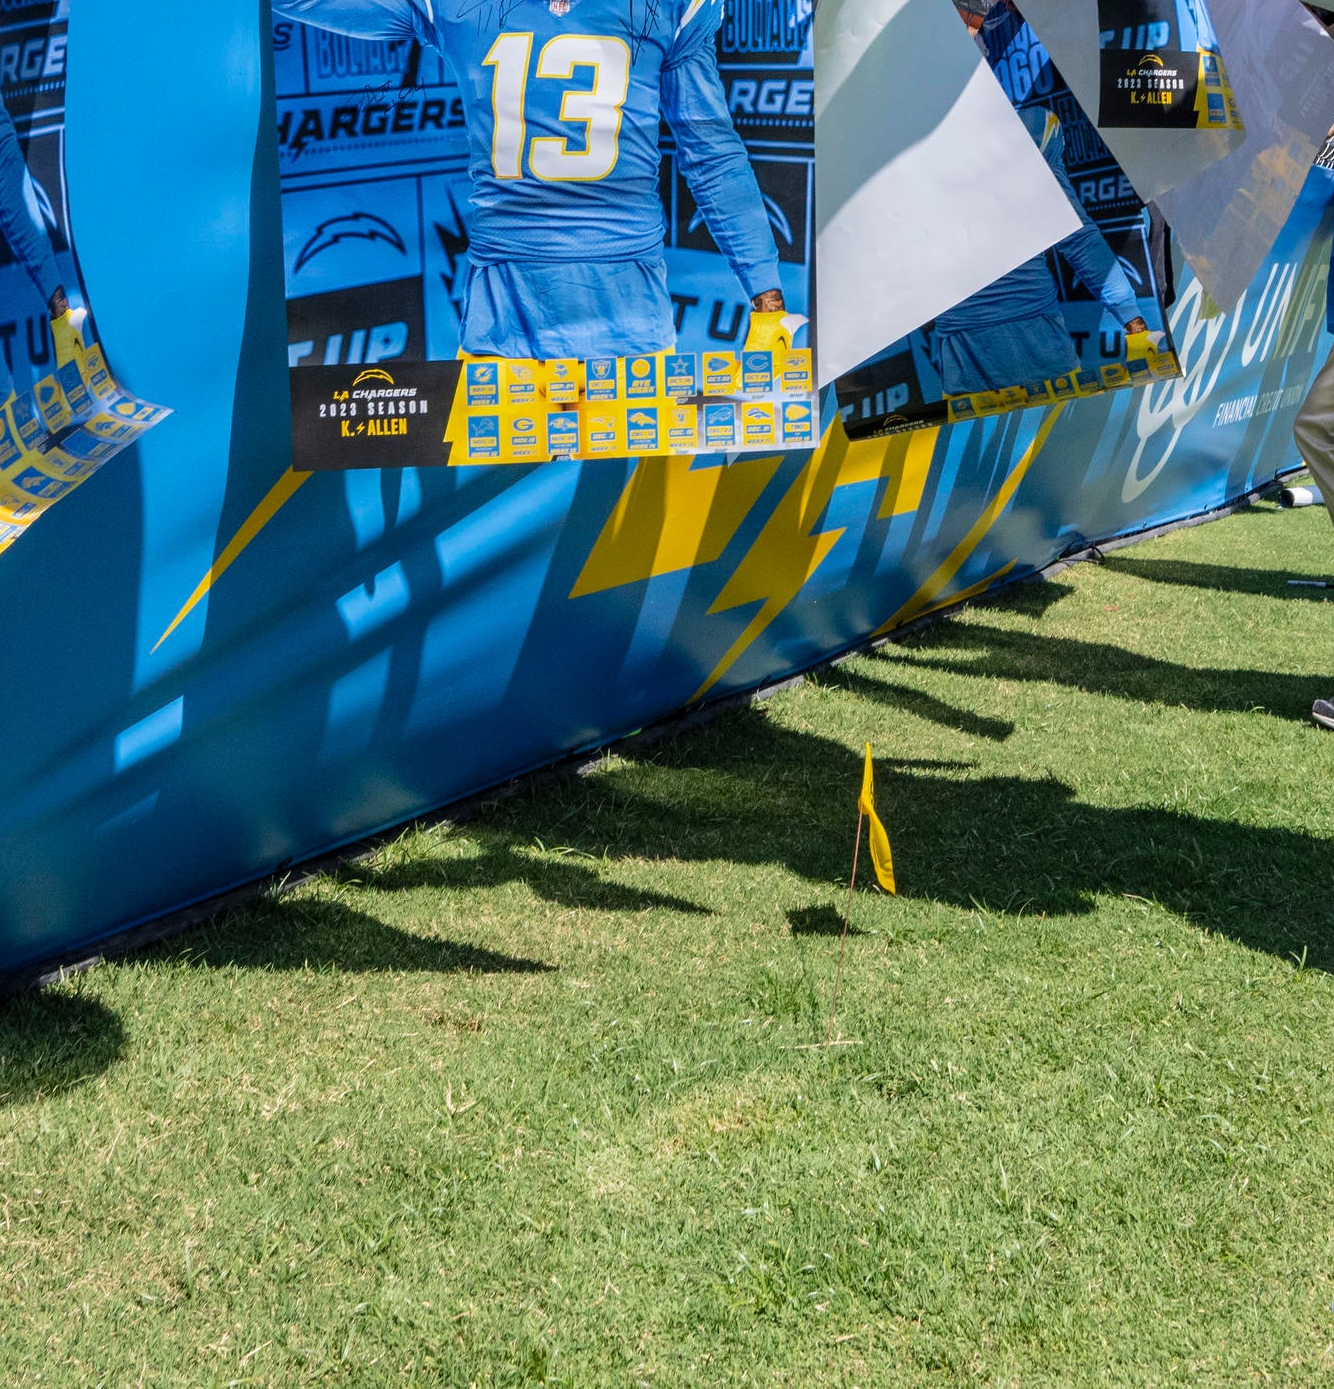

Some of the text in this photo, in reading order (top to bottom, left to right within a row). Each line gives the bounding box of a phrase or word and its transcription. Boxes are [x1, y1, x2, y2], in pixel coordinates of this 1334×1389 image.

[1126, 68, 1177, 78] LA CHARGERS
[1117, 78, 1184, 90] 2023 SEASON
[1130, 91, 1172, 105] K. ALLEN
[481, 31, 632, 183] 13
[332, 388, 418, 403] LA CHARGERS
[319, 400, 428, 417] 2023 SEASON
[1212, 394, 1259, 428] FINANCIAL
[1255, 388, 1284, 417] CREDIT
[341, 417, 408, 437] K. ALLEN
